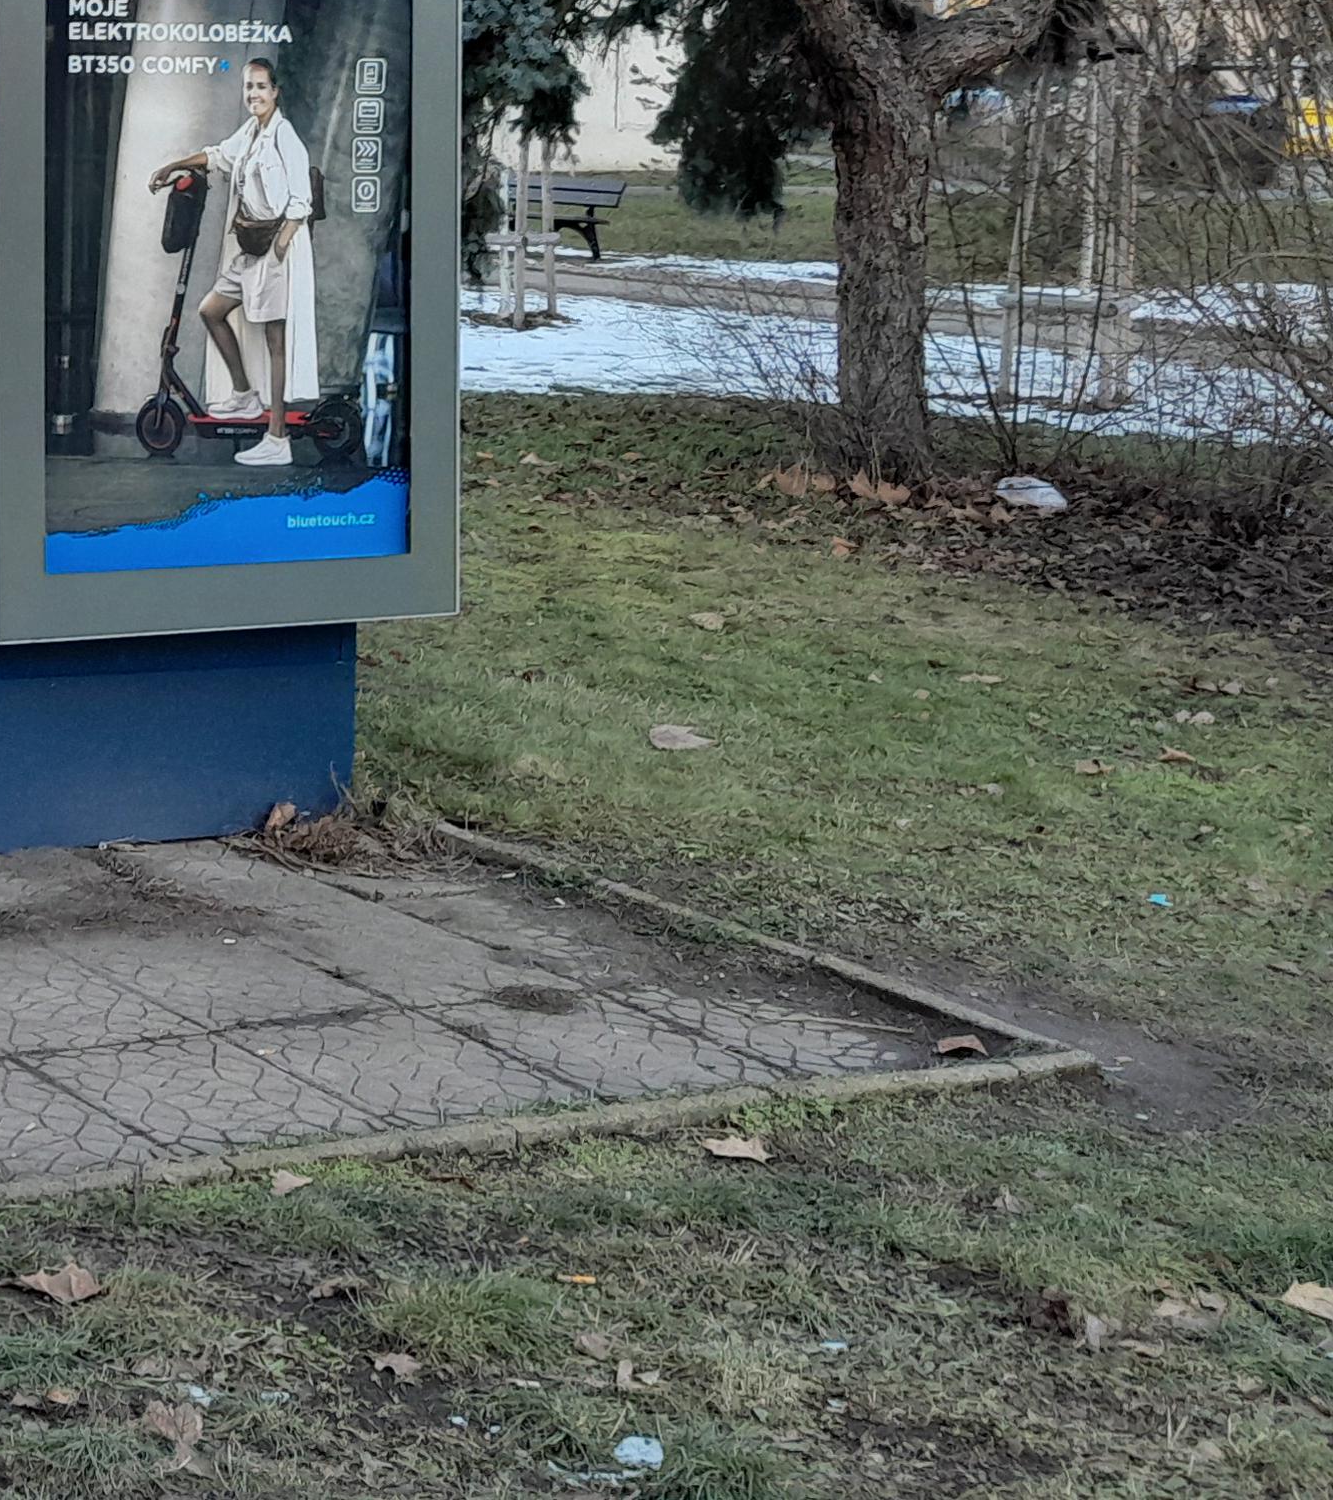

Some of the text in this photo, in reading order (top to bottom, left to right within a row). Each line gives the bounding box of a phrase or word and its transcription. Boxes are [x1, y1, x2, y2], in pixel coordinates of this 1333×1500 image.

[68, 19, 294, 44] ELEKTROKOLOBĚŽKA
[68, 55, 135, 75] BT350
[286, 512, 376, 529] bluetouch.cz
